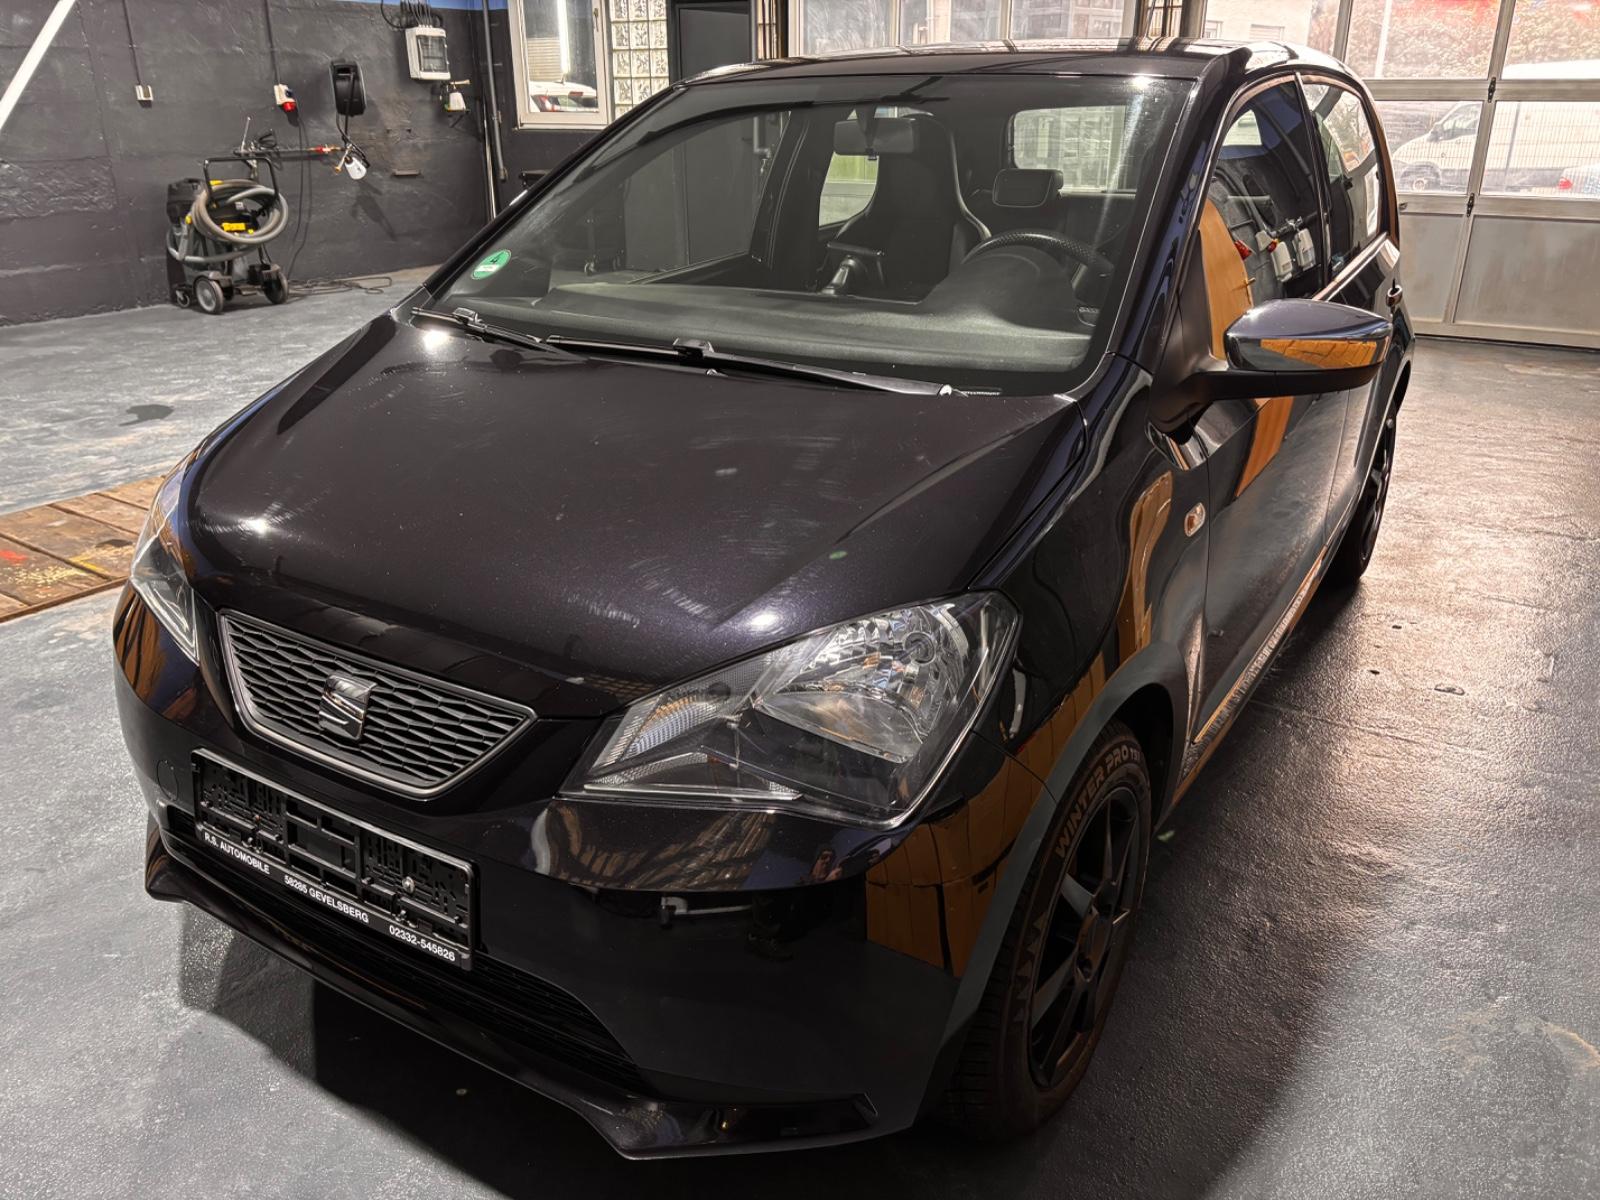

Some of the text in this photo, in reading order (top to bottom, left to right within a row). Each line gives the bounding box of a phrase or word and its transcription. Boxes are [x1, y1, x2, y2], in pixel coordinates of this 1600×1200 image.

[1053, 765, 1106, 858] WINTER
[1105, 743, 1129, 774] PRO
[220, 840, 271, 875] AUTOMOBILE
[308, 887, 369, 924] GEVELSBERG
[389, 924, 456, 962] 02332-545826
